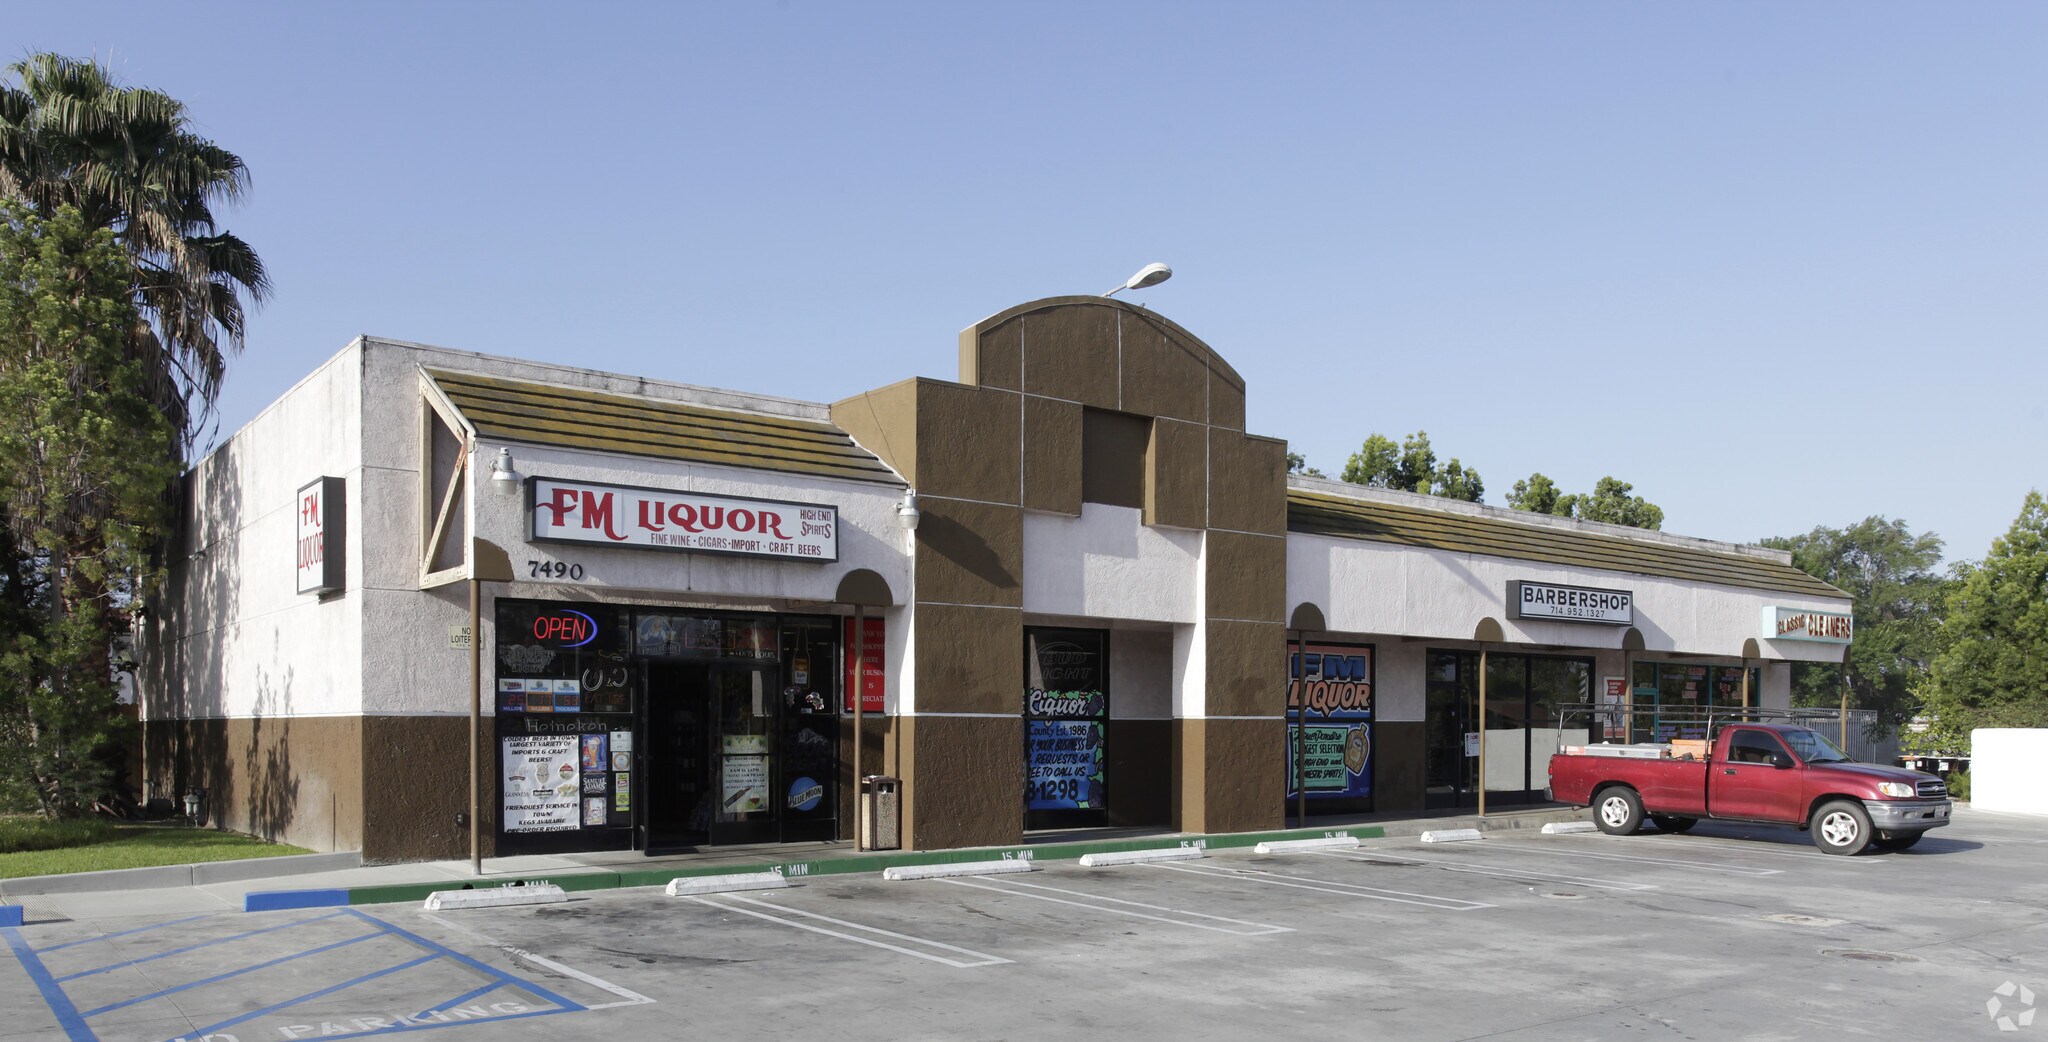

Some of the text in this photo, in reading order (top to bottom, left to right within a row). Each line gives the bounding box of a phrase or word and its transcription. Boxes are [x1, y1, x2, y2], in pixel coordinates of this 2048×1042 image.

[301, 491, 322, 528] FM
[536, 488, 793, 541] FM LIQUOR
[800, 509, 832, 521] HIGH END
[800, 521, 832, 539] SPIRITS
[651, 533, 822, 556] FINE WINE CIGARS IMPORT CRAFT BEERS
[527, 561, 583, 581] 7490
[1524, 587, 1629, 611] BARBERSHOP
[1551, 606, 1605, 618] 714.952.1327
[461, 626, 471, 635] NO
[533, 616, 587, 640] OPEN
[1778, 614, 1851, 639] CLASSIC CLEANERS
[1291, 653, 1366, 681] FM
[1288, 680, 1371, 716] LIQUOR
[1030, 690, 1087, 726] Liquor
[524, 717, 607, 732] Heineken
[1069, 725, 1087, 736] 1986
[1320, 743, 1344, 754] SELECTION
[1035, 753, 1091, 765] REQUESTS OR
[1042, 766, 1053, 777] TO
[1054, 767, 1072, 777] CALL
[1074, 766, 1086, 777] US
[584, 782, 607, 793] ADAMS
[805, 786, 822, 799] MOON
[1193, 839, 1206, 849] MIN
[1002, 850, 1033, 860] 15 MIN
[770, 864, 808, 875] 15 MIN
[278, 1002, 529, 1039] PARKING
